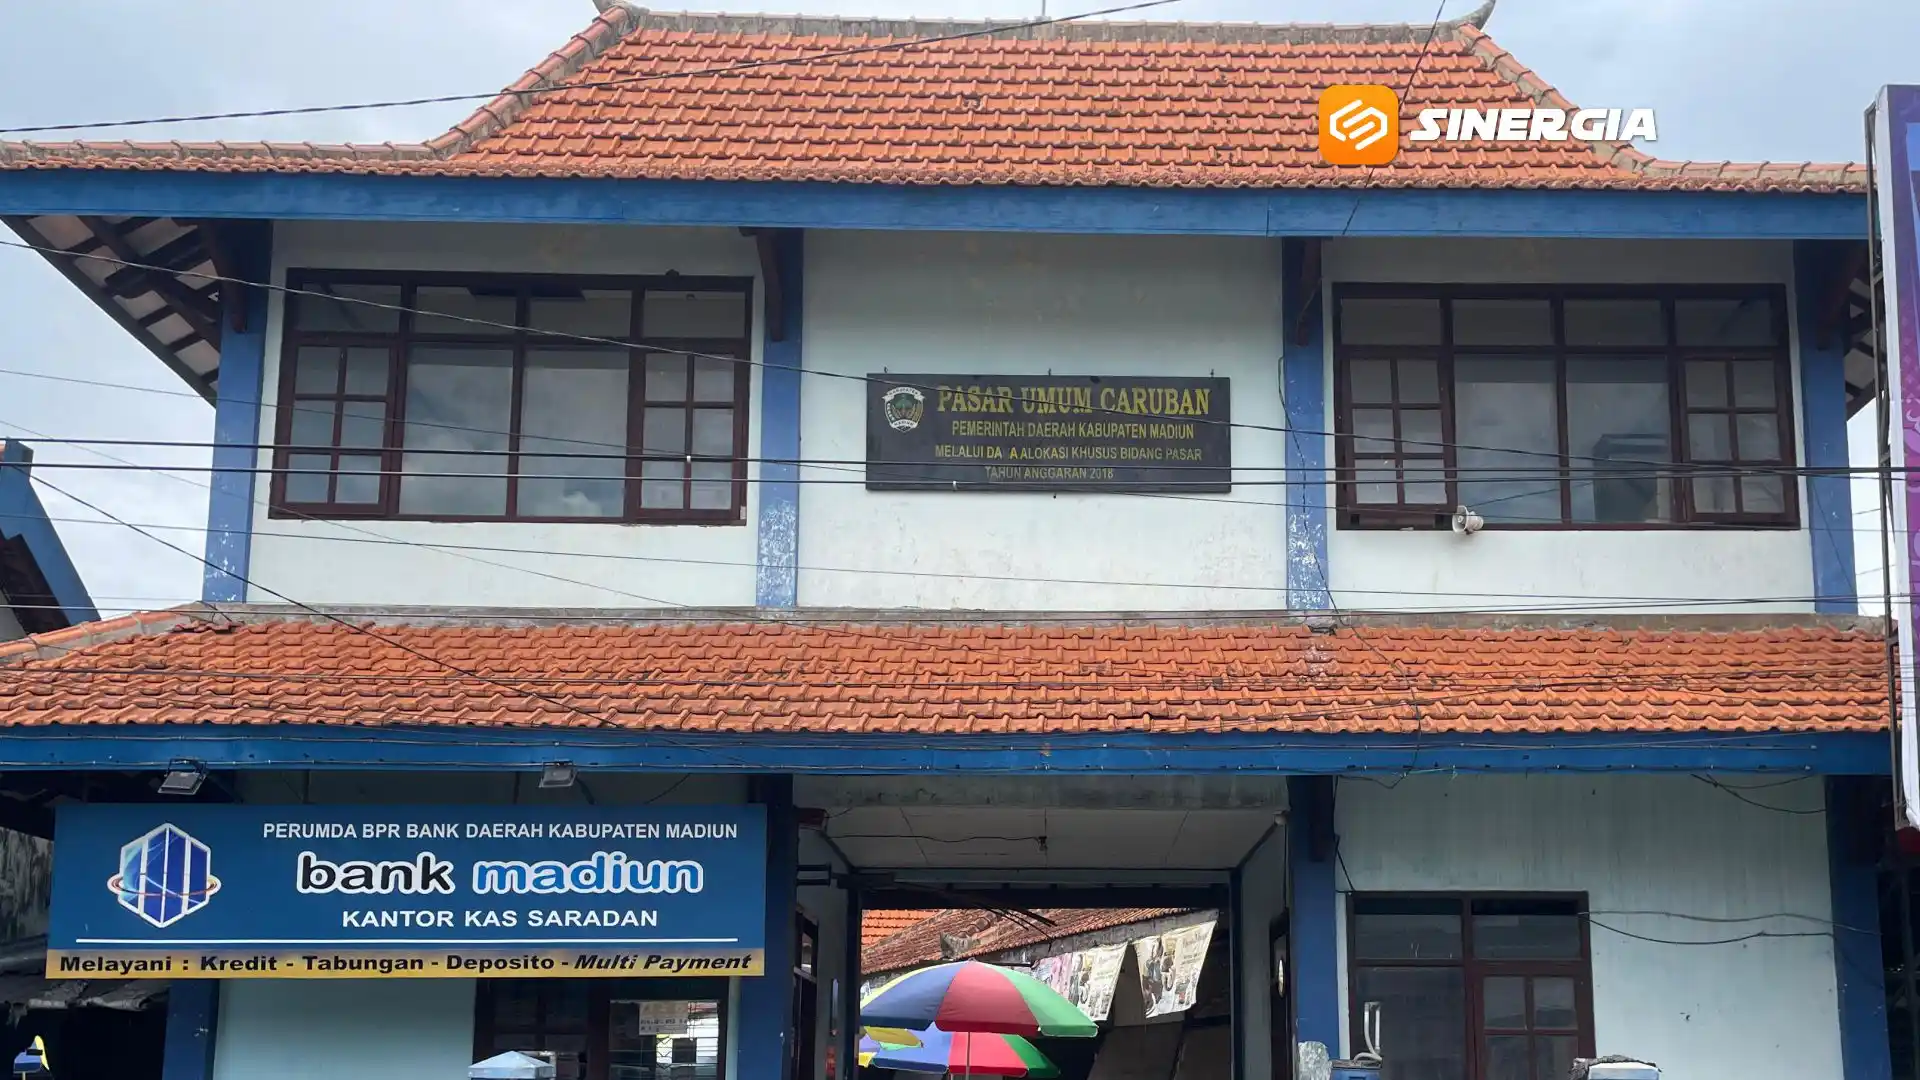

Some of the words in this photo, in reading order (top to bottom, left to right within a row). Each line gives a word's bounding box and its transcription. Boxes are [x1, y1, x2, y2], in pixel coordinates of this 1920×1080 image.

[937, 386, 1014, 413] PASAR
[1022, 387, 1092, 414] UMUM
[1101, 388, 1211, 416] CARUBAN
[952, 420, 1024, 437] PEMERINTAH
[1028, 422, 1074, 437] DAERAH
[1079, 422, 1147, 439] KABUPATEN
[1150, 423, 1194, 439] MADIUN
[935, 444, 984, 458] MELALUI
[1020, 447, 1069, 460] ALOKASI
[1072, 447, 1117, 460] KHUSUS
[1120, 447, 1162, 460] BIDANG
[1165, 448, 1202, 461] PASAR
[985, 466, 1021, 480] TAHUN
[1024, 466, 1087, 480] ANGGARAN
[1089, 467, 1114, 480] 2018
[263, 823, 357, 839] PERUMDA
[362, 823, 400, 839] BPR
[406, 823, 460, 839] BANK
[466, 823, 543, 839] DAERAH
[548, 823, 660, 839] KABUPATEN
[666, 823, 738, 839] MADIUN
[297, 851, 455, 894] bank
[473, 851, 704, 894] madiun
[342, 910, 454, 928] KANTOR
[464, 910, 518, 928] KAS
[528, 910, 658, 928] SARADAN
[60, 956, 172, 975] Melayani
[201, 956, 277, 971] Kredit
[302, 955, 424, 974] Tabungan
[446, 955, 555, 973] Deposito
[574, 954, 637, 970] Multi
[643, 954, 752, 973] Payment
